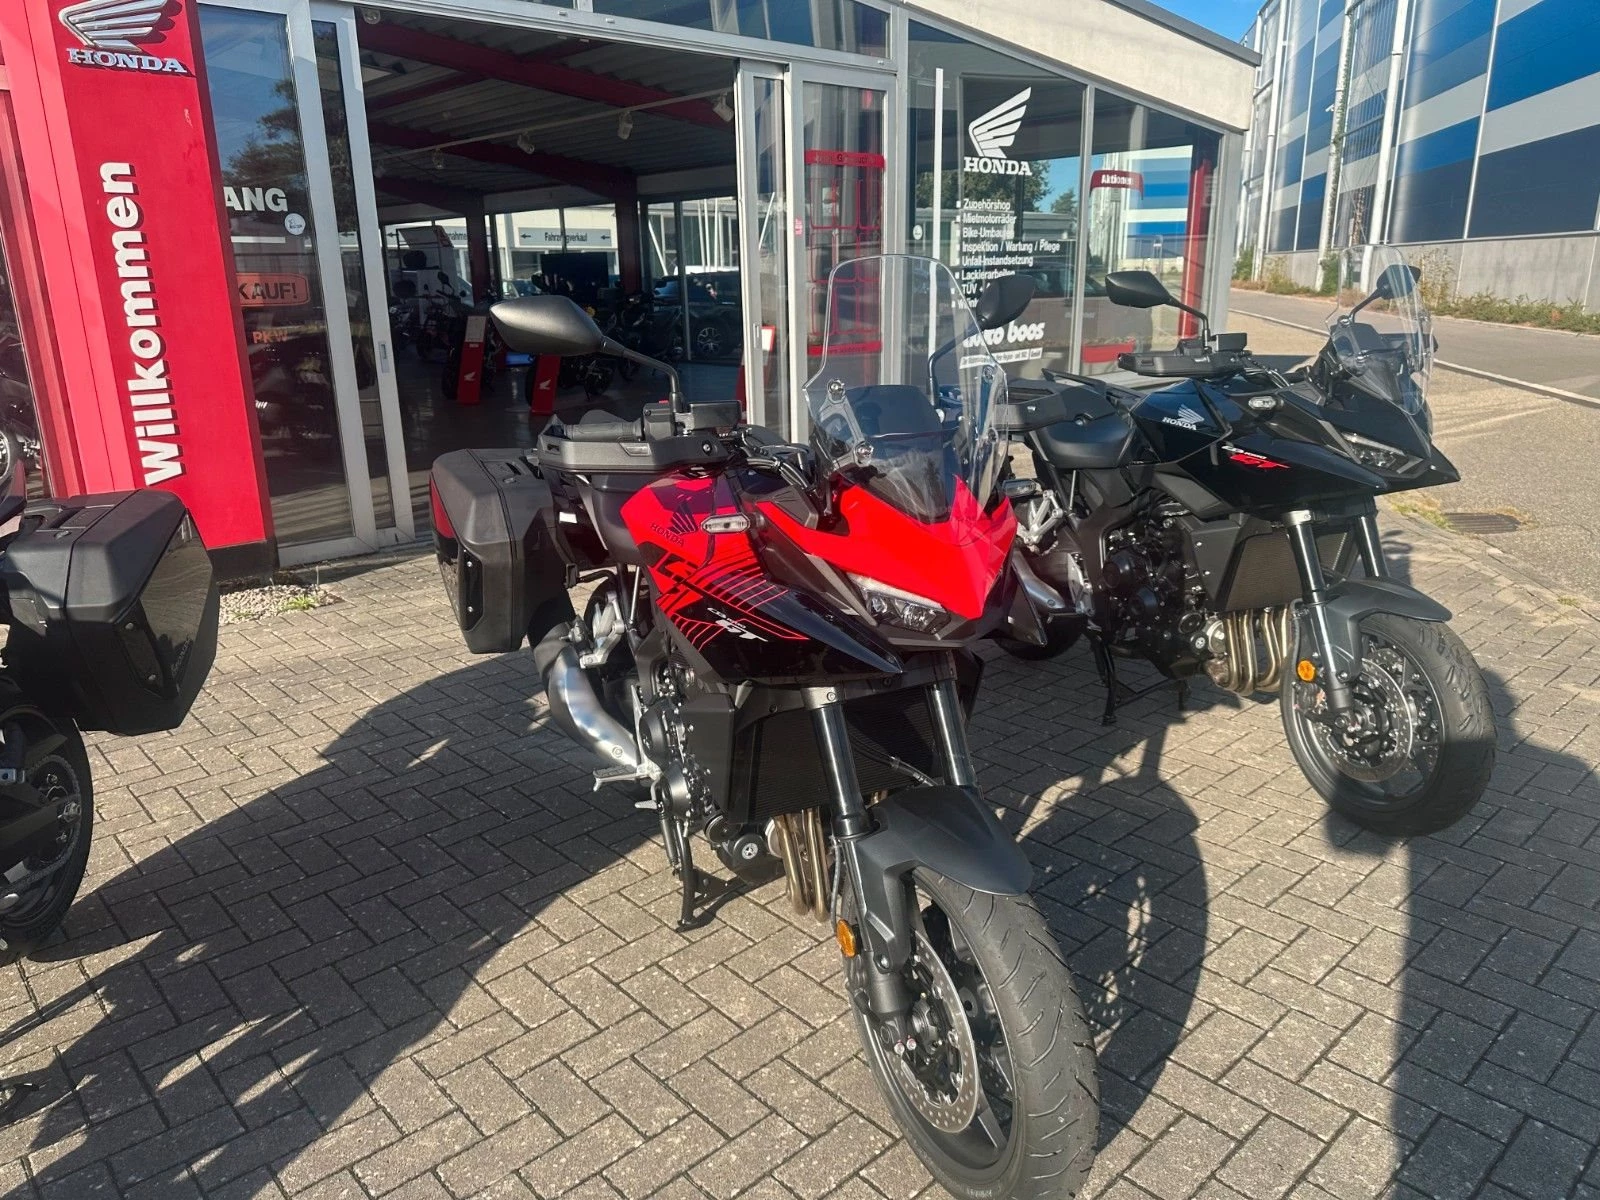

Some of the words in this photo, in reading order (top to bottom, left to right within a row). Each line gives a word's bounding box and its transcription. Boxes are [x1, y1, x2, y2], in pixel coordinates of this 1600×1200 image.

[66, 48, 187, 73] HONDA
[963, 156, 1033, 176] HONDA
[963, 199, 1010, 212] Zubehörshop
[962, 212, 1016, 225] Mietmotorräder
[962, 241, 999, 254] Inspektion
[1005, 241, 1033, 253] Wartung
[1039, 238, 1060, 253] Pflege
[100, 162, 183, 486] Willkommen
[1007, 320, 1045, 343] boos
[1162, 416, 1197, 431] HONDA
[650, 522, 685, 547] HONDA
